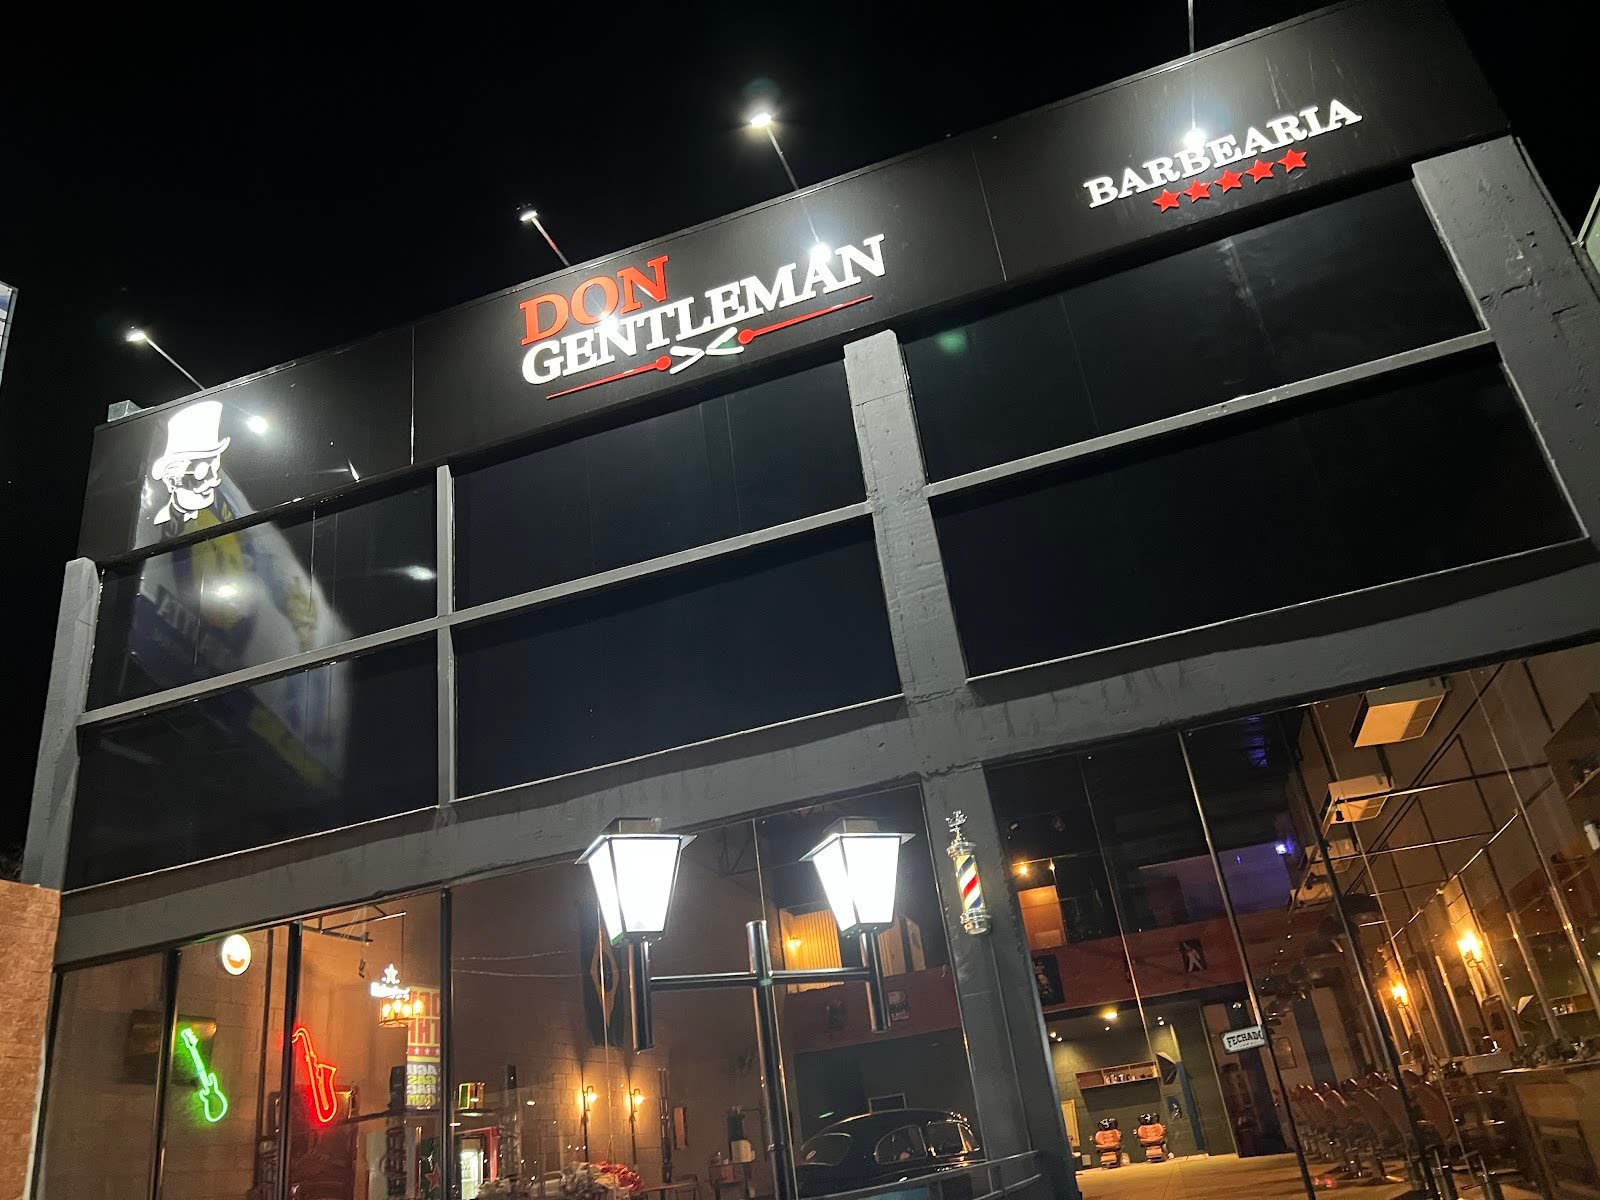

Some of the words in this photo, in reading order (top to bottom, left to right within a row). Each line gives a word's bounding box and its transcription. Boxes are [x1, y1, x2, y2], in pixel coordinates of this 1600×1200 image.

[1083, 99, 1362, 208] BARBEARIA
[519, 255, 670, 345] DON
[521, 234, 886, 385] GENTLEMAN
